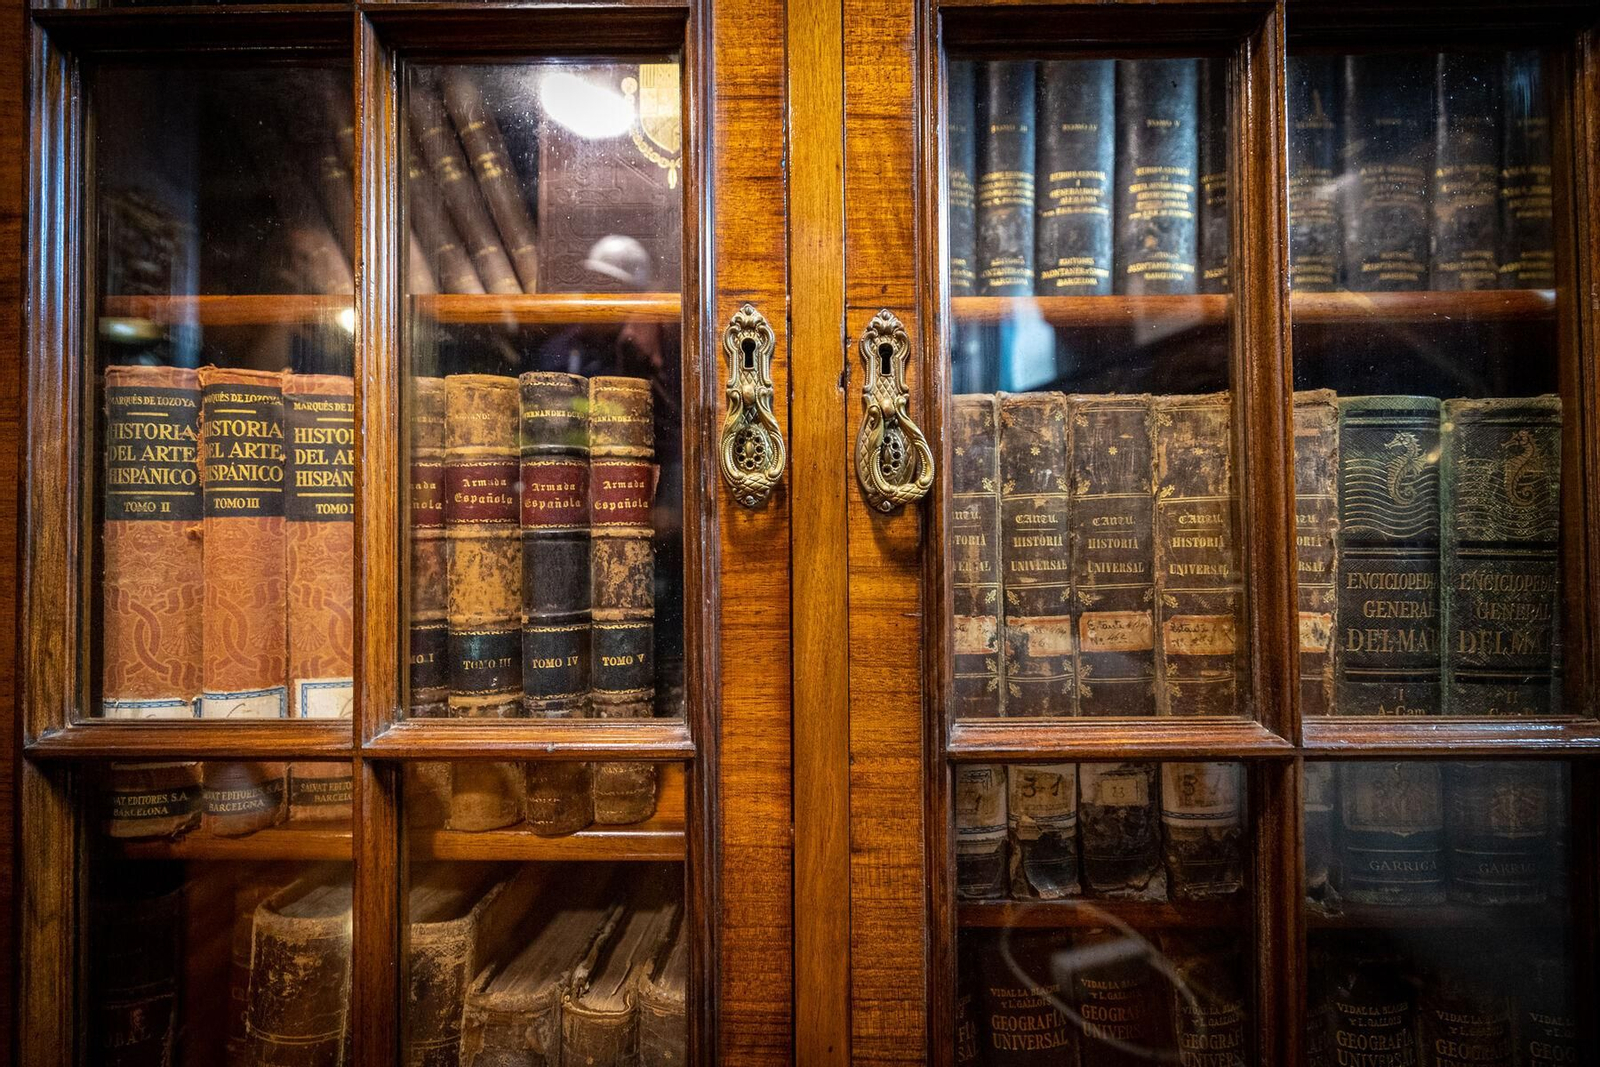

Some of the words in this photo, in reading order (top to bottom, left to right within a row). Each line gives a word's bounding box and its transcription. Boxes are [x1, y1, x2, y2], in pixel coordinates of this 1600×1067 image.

[143, 396, 156, 405] DE
[157, 396, 196, 408] LOZOYA
[231, 393, 244, 403] DE
[293, 400, 334, 412] MARQUÉS
[334, 403, 347, 411] DE
[109, 421, 198, 441] HISTORIA
[108, 445, 136, 461] DEL
[140, 445, 197, 463] ARTE
[228, 441, 285, 460] ARTE
[295, 449, 329, 465] DEL
[109, 465, 197, 486] HISPÁNICO
[462, 478, 507, 487] Armada
[531, 482, 576, 492] Armada
[603, 480, 645, 490] Armada
[213, 498, 245, 509] TOMO
[246, 497, 260, 509] III
[454, 493, 514, 504] Española
[524, 497, 581, 510] Española
[594, 498, 649, 511] Española
[124, 501, 157, 513] TOMO
[160, 501, 171, 513] II
[315, 504, 349, 514] TOMO
[1013, 534, 1063, 547] HISTORIA
[1088, 537, 1139, 549] HISTORIA
[1172, 536, 1225, 548] HISTORIA
[1011, 559, 1068, 571] UNIVERSAL
[1087, 560, 1145, 573] UNIVERSAL
[1169, 563, 1229, 576] UNIVERSAL
[1363, 600, 1435, 618] GENERAL
[1476, 601, 1551, 620] GENERAL
[1346, 628, 1395, 653] DEL
[1457, 629, 1505, 655] DEL
[532, 658, 563, 669] TOMO
[567, 656, 579, 667] IV
[602, 656, 633, 667] TOMO
[637, 654, 645, 664] V
[208, 799, 265, 811] BARCELONA
[990, 988, 1017, 997] VIDAL
[1017, 988, 1028, 997] LA
[991, 1028, 1068, 1050] UNIVERSAL
